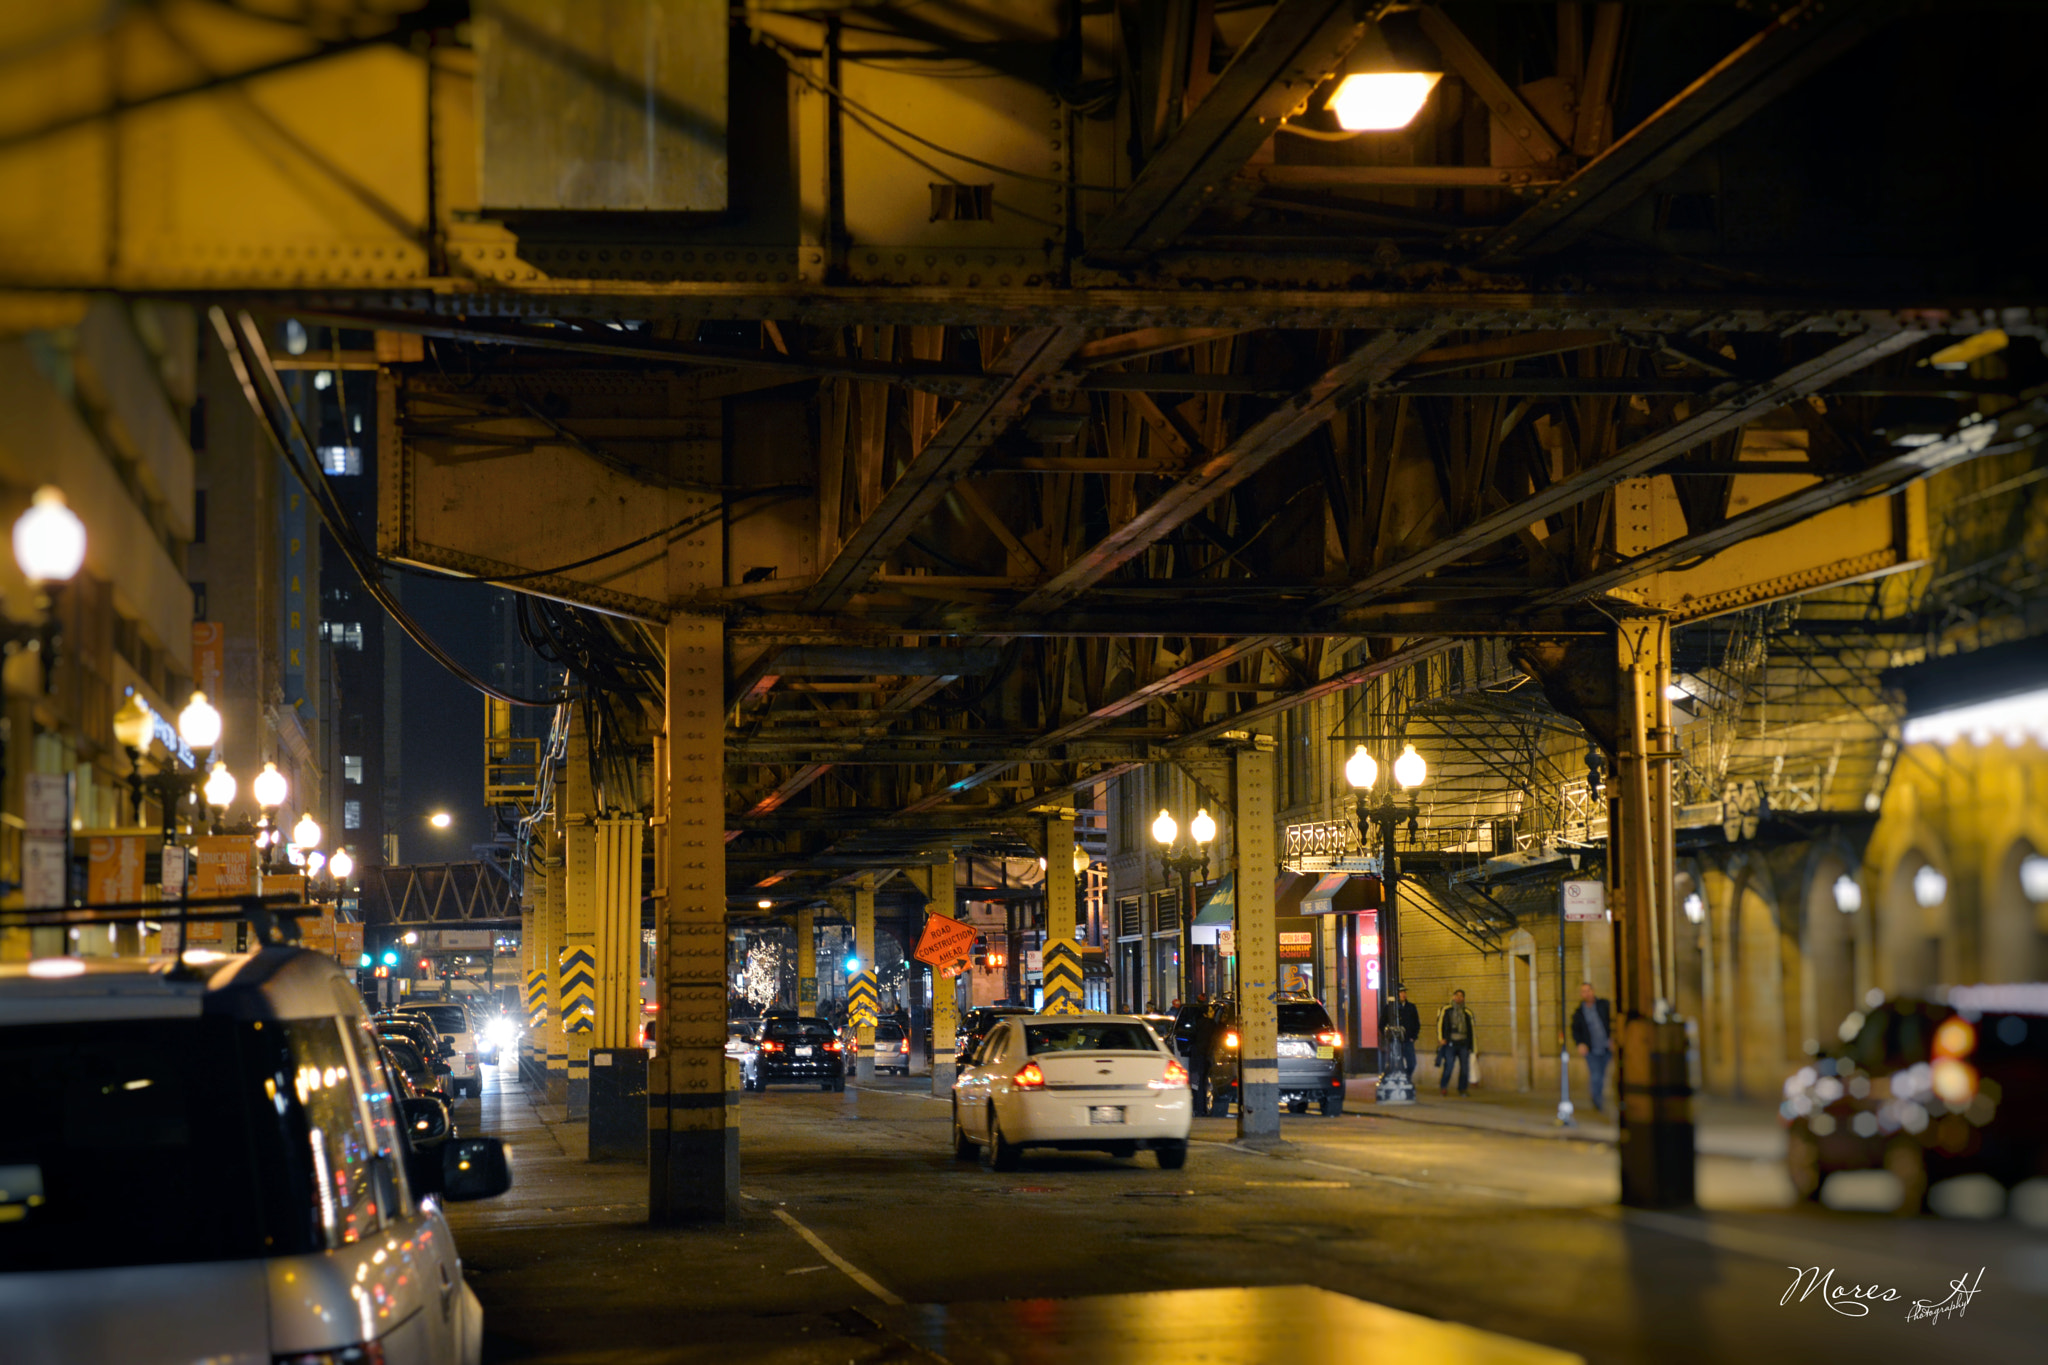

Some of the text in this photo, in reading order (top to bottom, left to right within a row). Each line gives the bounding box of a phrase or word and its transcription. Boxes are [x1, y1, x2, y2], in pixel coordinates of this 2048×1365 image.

[289, 538, 301, 667] PARK
[198, 852, 247, 864] EDUCATION
[226, 864, 247, 873] THAT
[214, 874, 248, 886] WORKS
[930, 924, 952, 939] ROAD
[918, 928, 973, 958] CONSTRUCTION
[1280, 934, 1310, 943] OPEN 24 HRS
[1279, 944, 1312, 952] DUNKIN'
[938, 946, 963, 963] AHEAD
